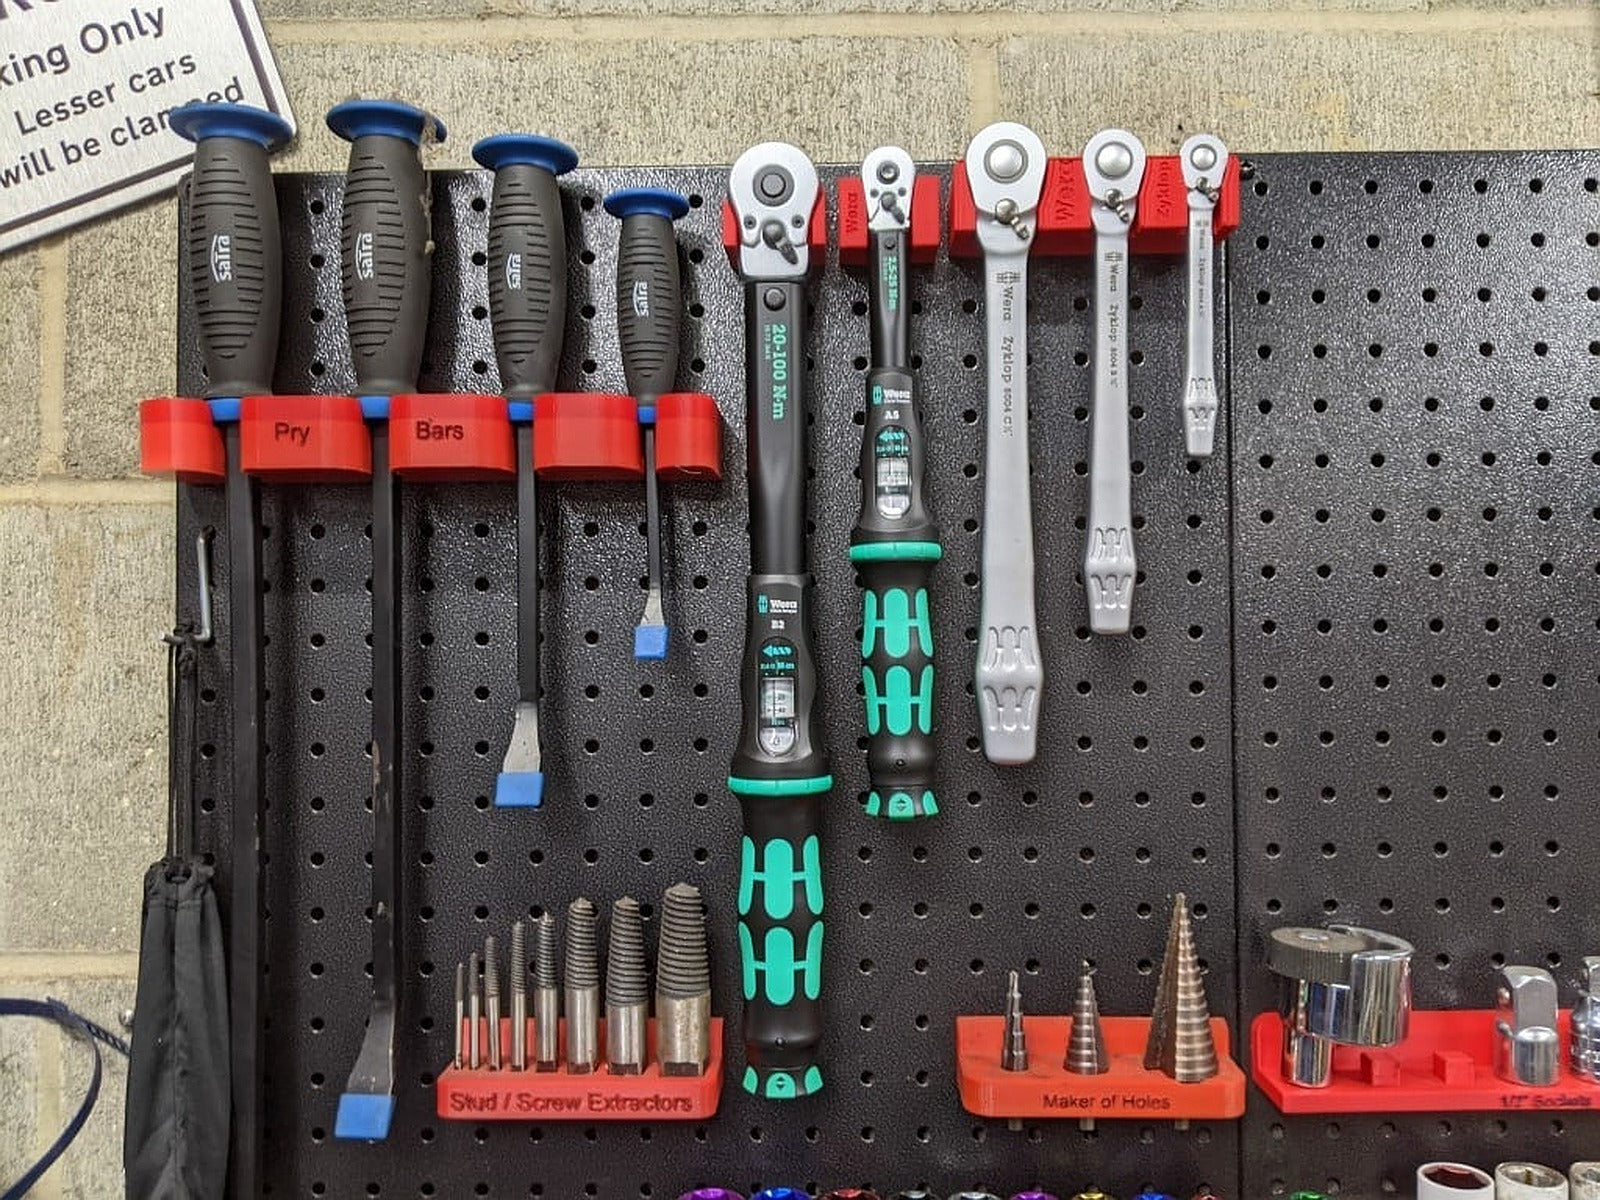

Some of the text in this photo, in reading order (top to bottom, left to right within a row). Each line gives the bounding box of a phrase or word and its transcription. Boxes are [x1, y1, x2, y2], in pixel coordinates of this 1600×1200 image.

[80, 7, 165, 53] Only
[15, 54, 196, 135] Lesser cars
[0, 147, 55, 188] will
[61, 138, 101, 166] be
[1110, 264, 1119, 292] Wera
[1002, 286, 1014, 321] Wera
[1107, 303, 1119, 342] Zyklop
[772, 324, 787, 380] 20-100
[1001, 336, 1014, 384] Zyklop
[274, 420, 465, 447] Pry Bars
[450, 1092, 694, 1113] Stud / Screw Extractors
[1042, 1094, 1172, 1110] Maker of Holes
